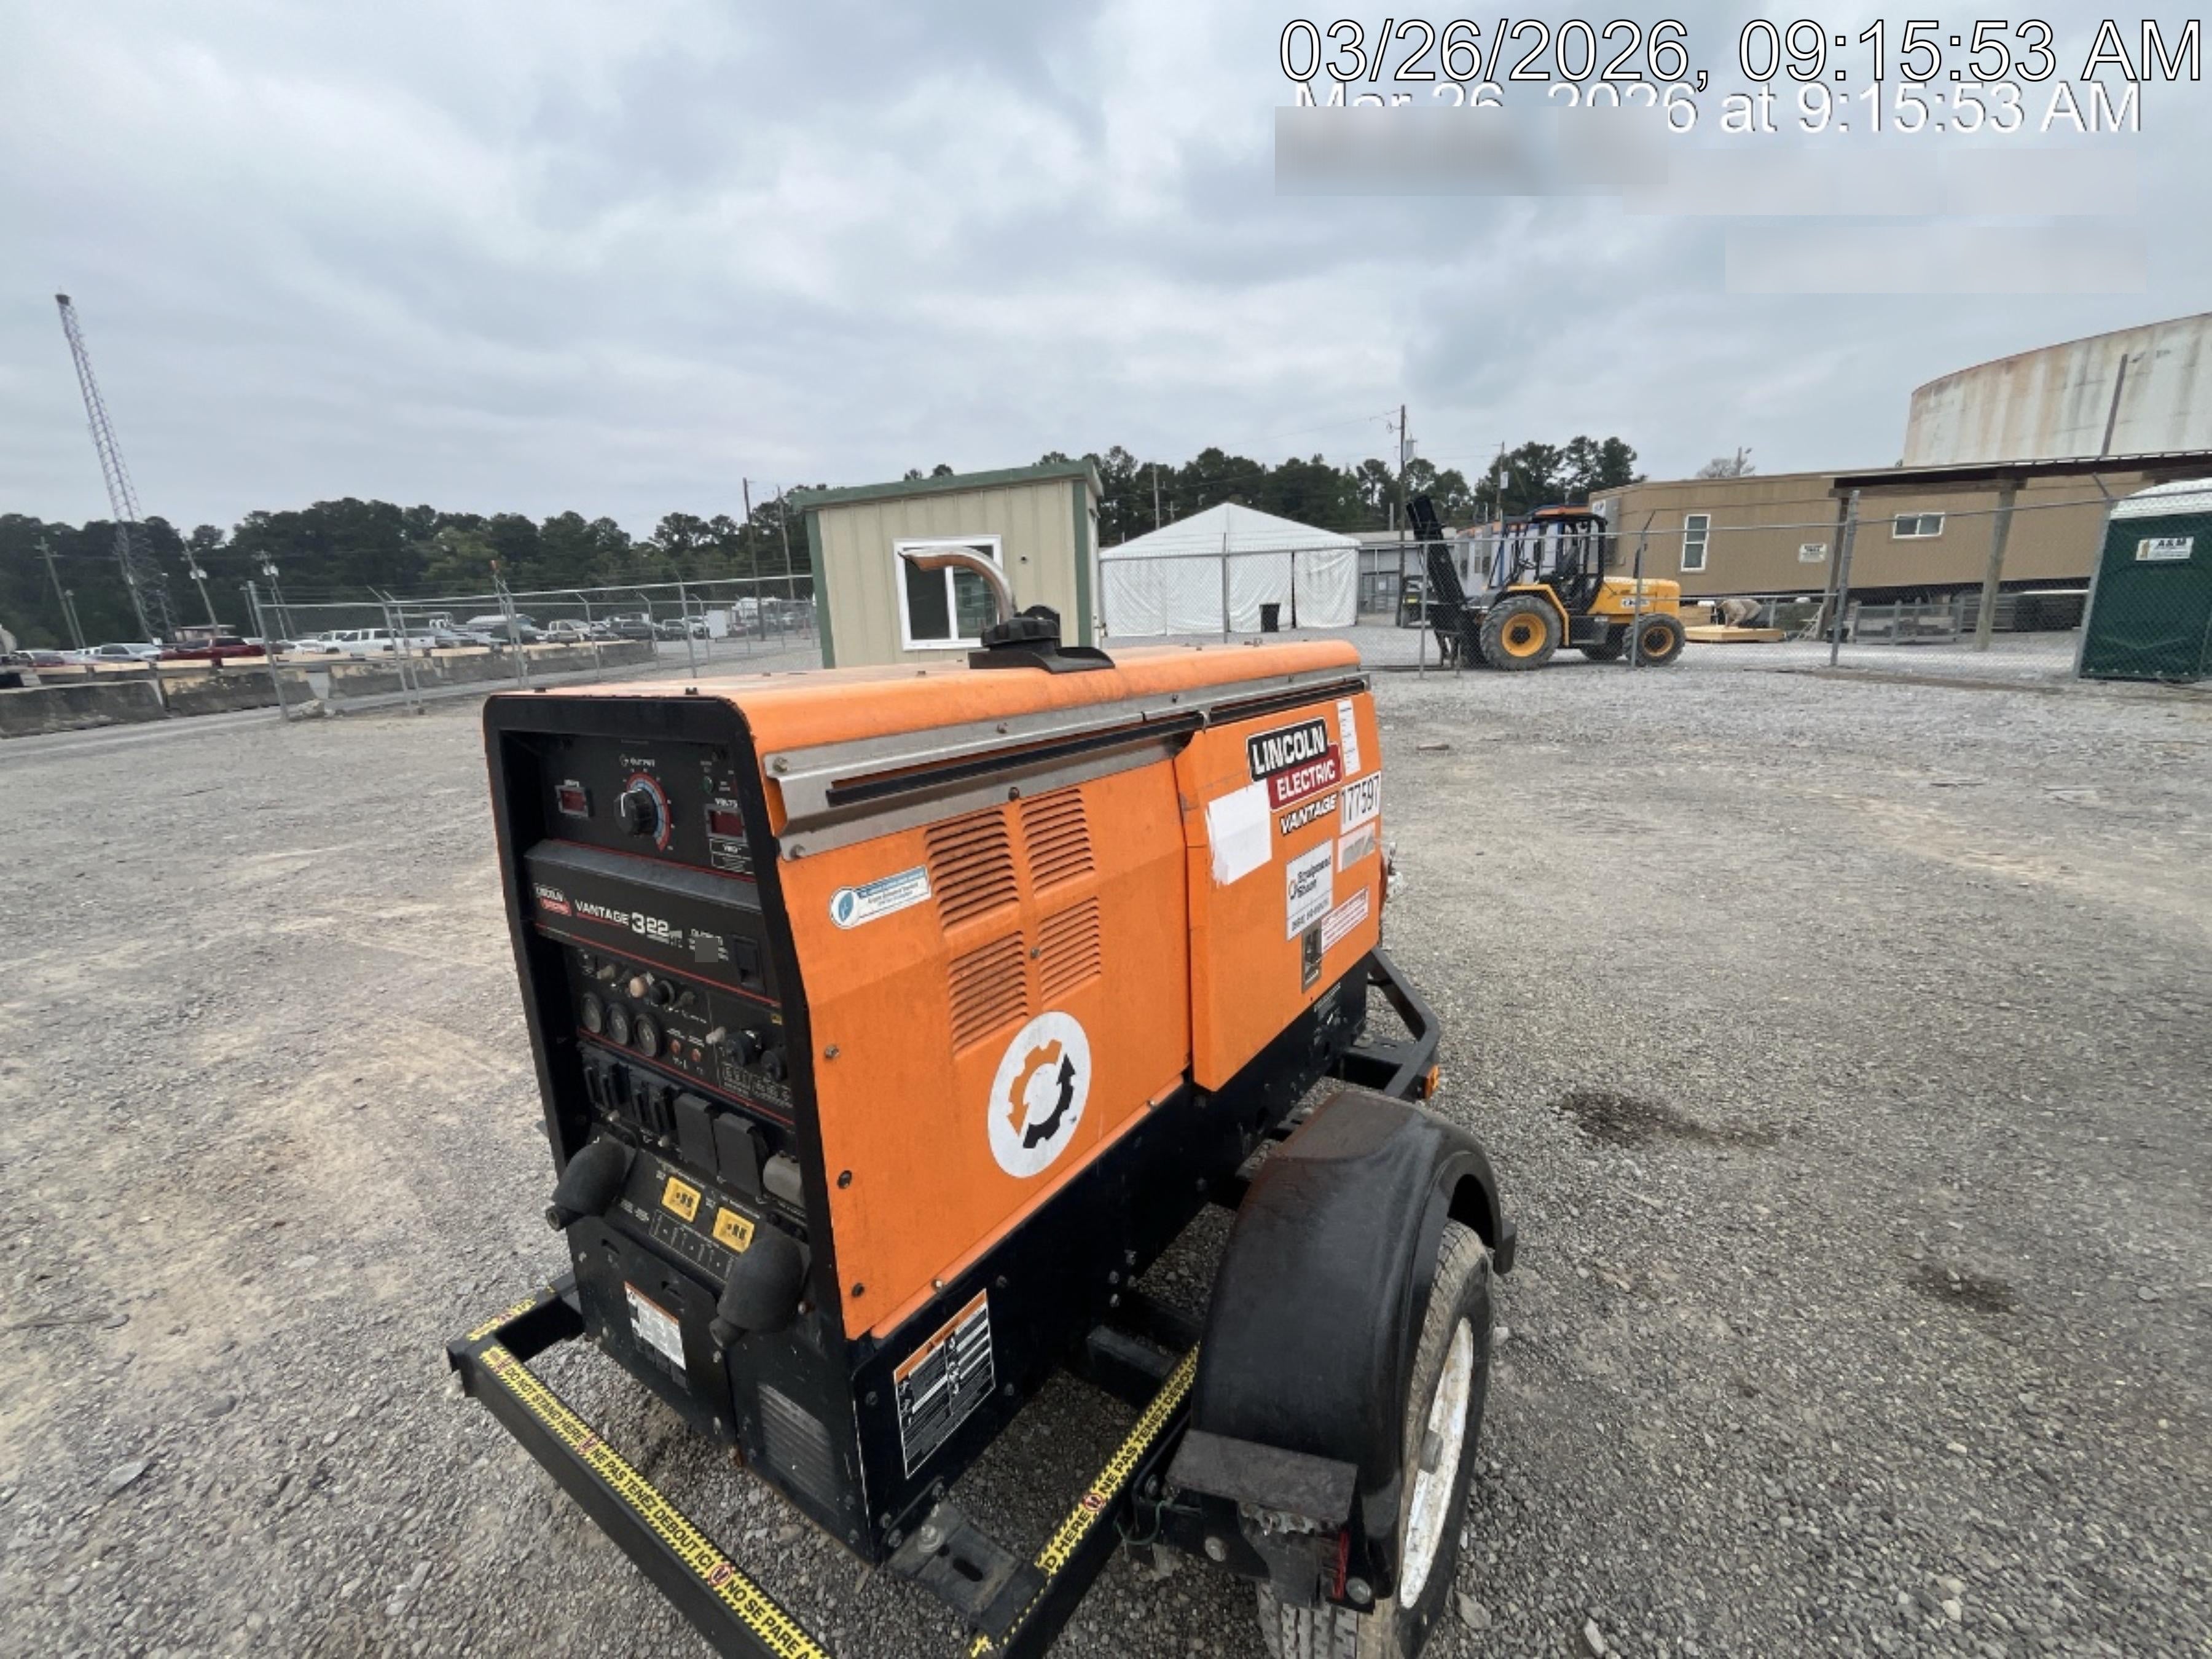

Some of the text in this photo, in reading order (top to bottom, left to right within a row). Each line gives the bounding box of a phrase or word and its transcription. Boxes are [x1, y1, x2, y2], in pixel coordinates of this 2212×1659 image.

[1252, 726, 1325, 775] LINCOLN
[1276, 759, 1336, 801] ELECTRIC
[1279, 792, 1339, 836] VANTAGE
[574, 899, 630, 926] VANTAGE
[631, 912, 669, 935] 322
[1054, 1510, 1091, 1555] HERE
[1097, 1473, 1117, 1494] NE
[1114, 1447, 1138, 1473] PAS
[603, 1459, 628, 1481] PAS
[622, 1477, 659, 1512] TENEZ
[653, 1507, 700, 1553] DEBOUT
[694, 1550, 716, 1569] ICI
[724, 1579, 747, 1602] NO
[744, 1598, 766, 1621] SE
[761, 1615, 802, 1656] PARE
